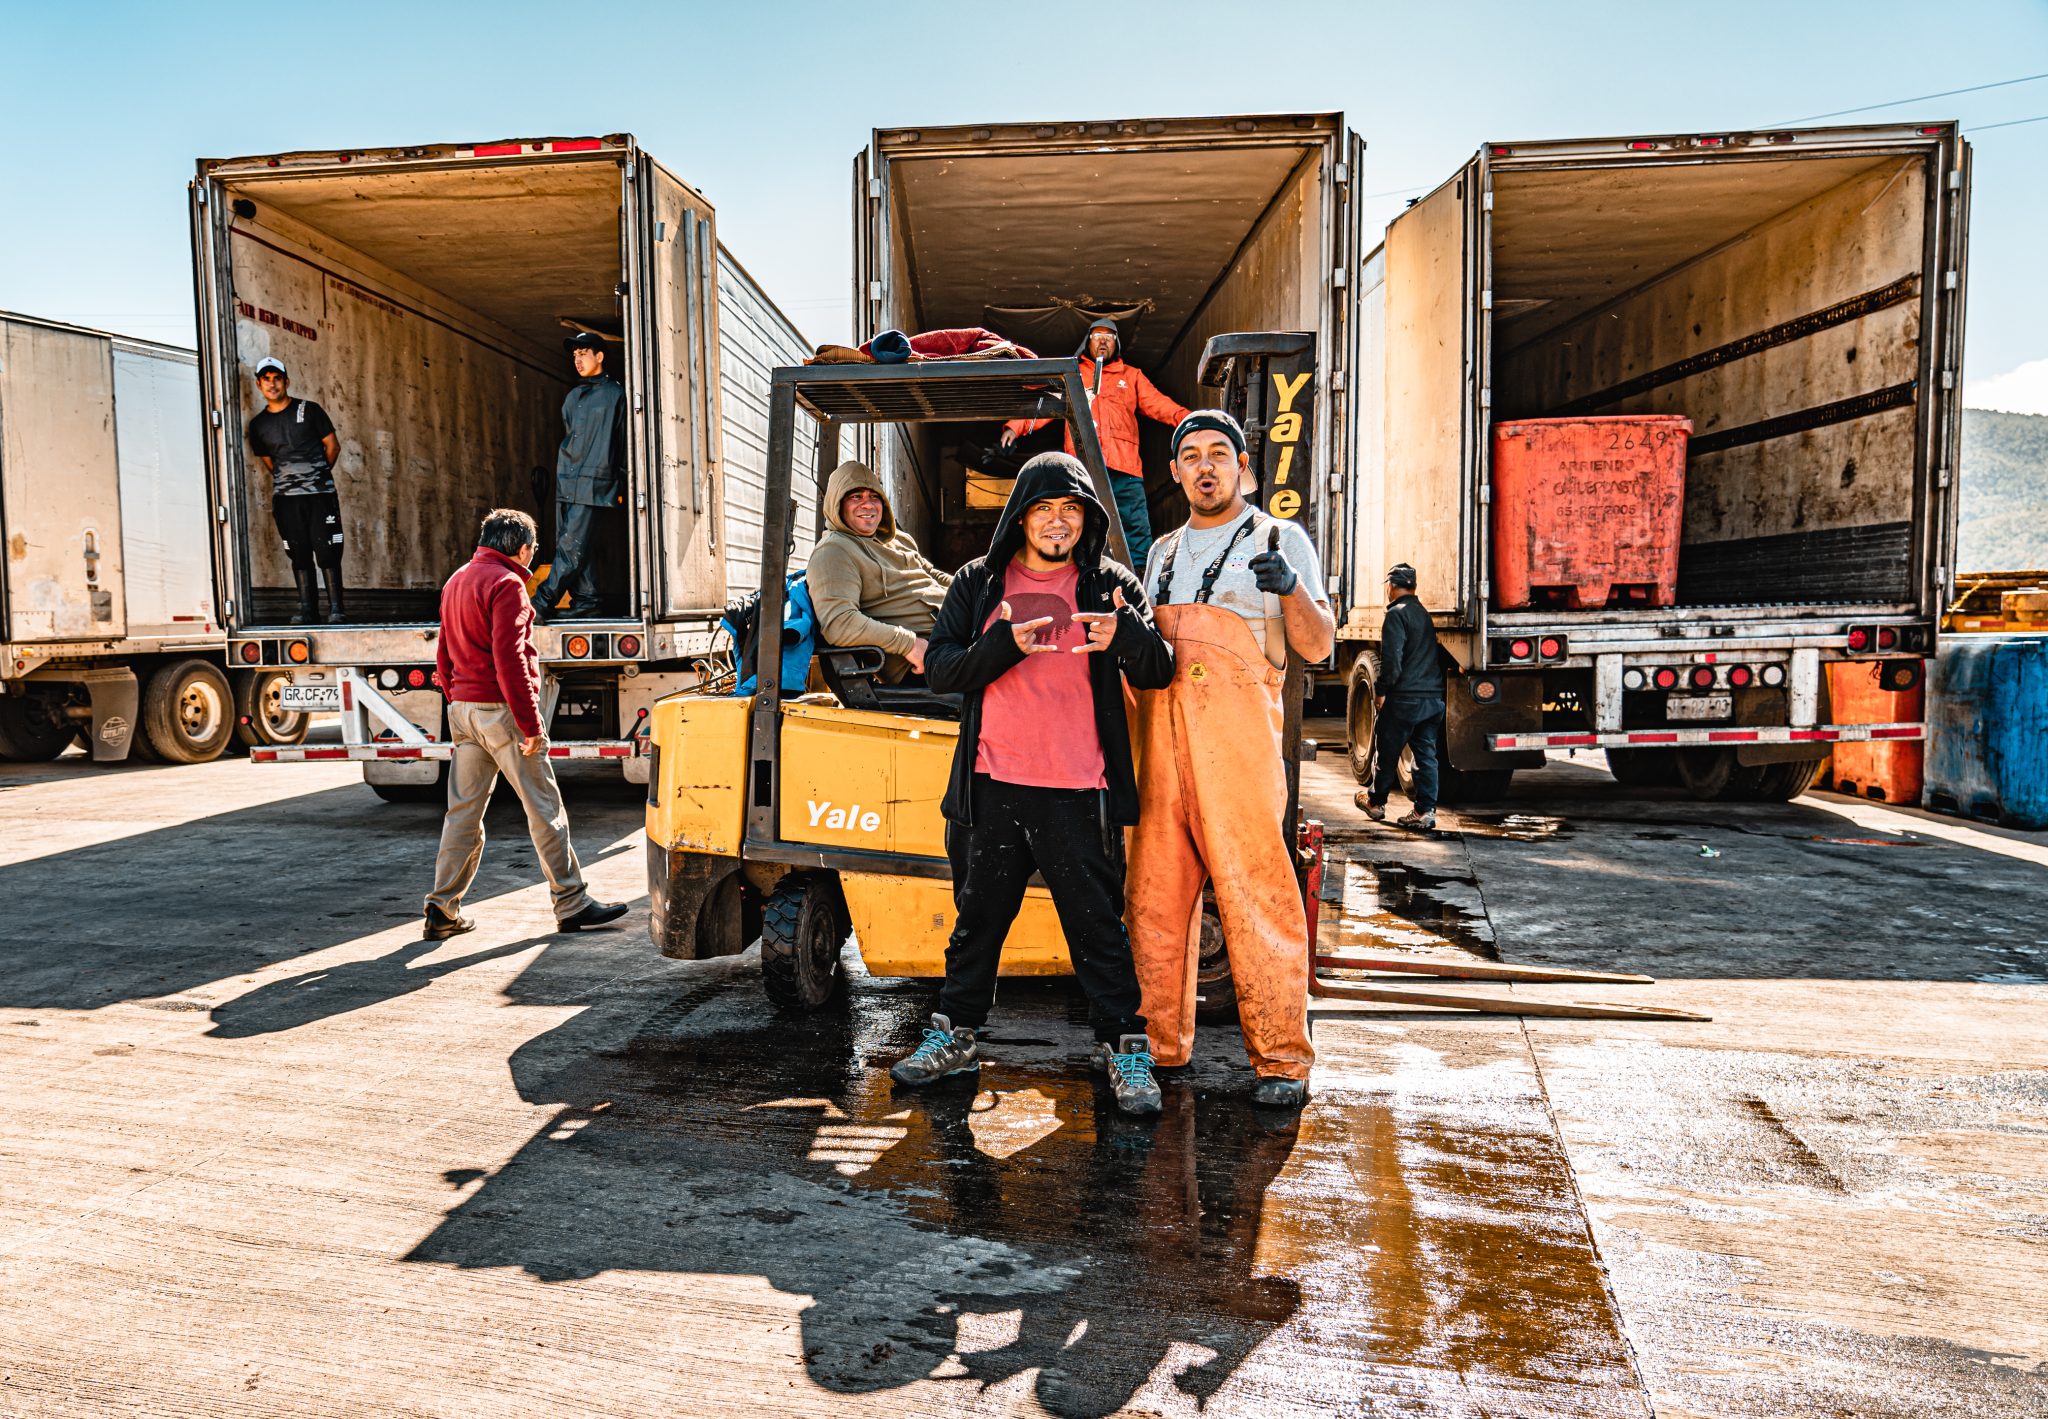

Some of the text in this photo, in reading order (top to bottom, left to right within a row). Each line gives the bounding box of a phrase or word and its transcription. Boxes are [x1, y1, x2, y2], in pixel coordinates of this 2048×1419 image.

[1269, 373, 1312, 519] Yale
[1609, 431, 1666, 450] 2649
[102, 726, 128, 739] UTILITY
[807, 800, 881, 832] Yale
